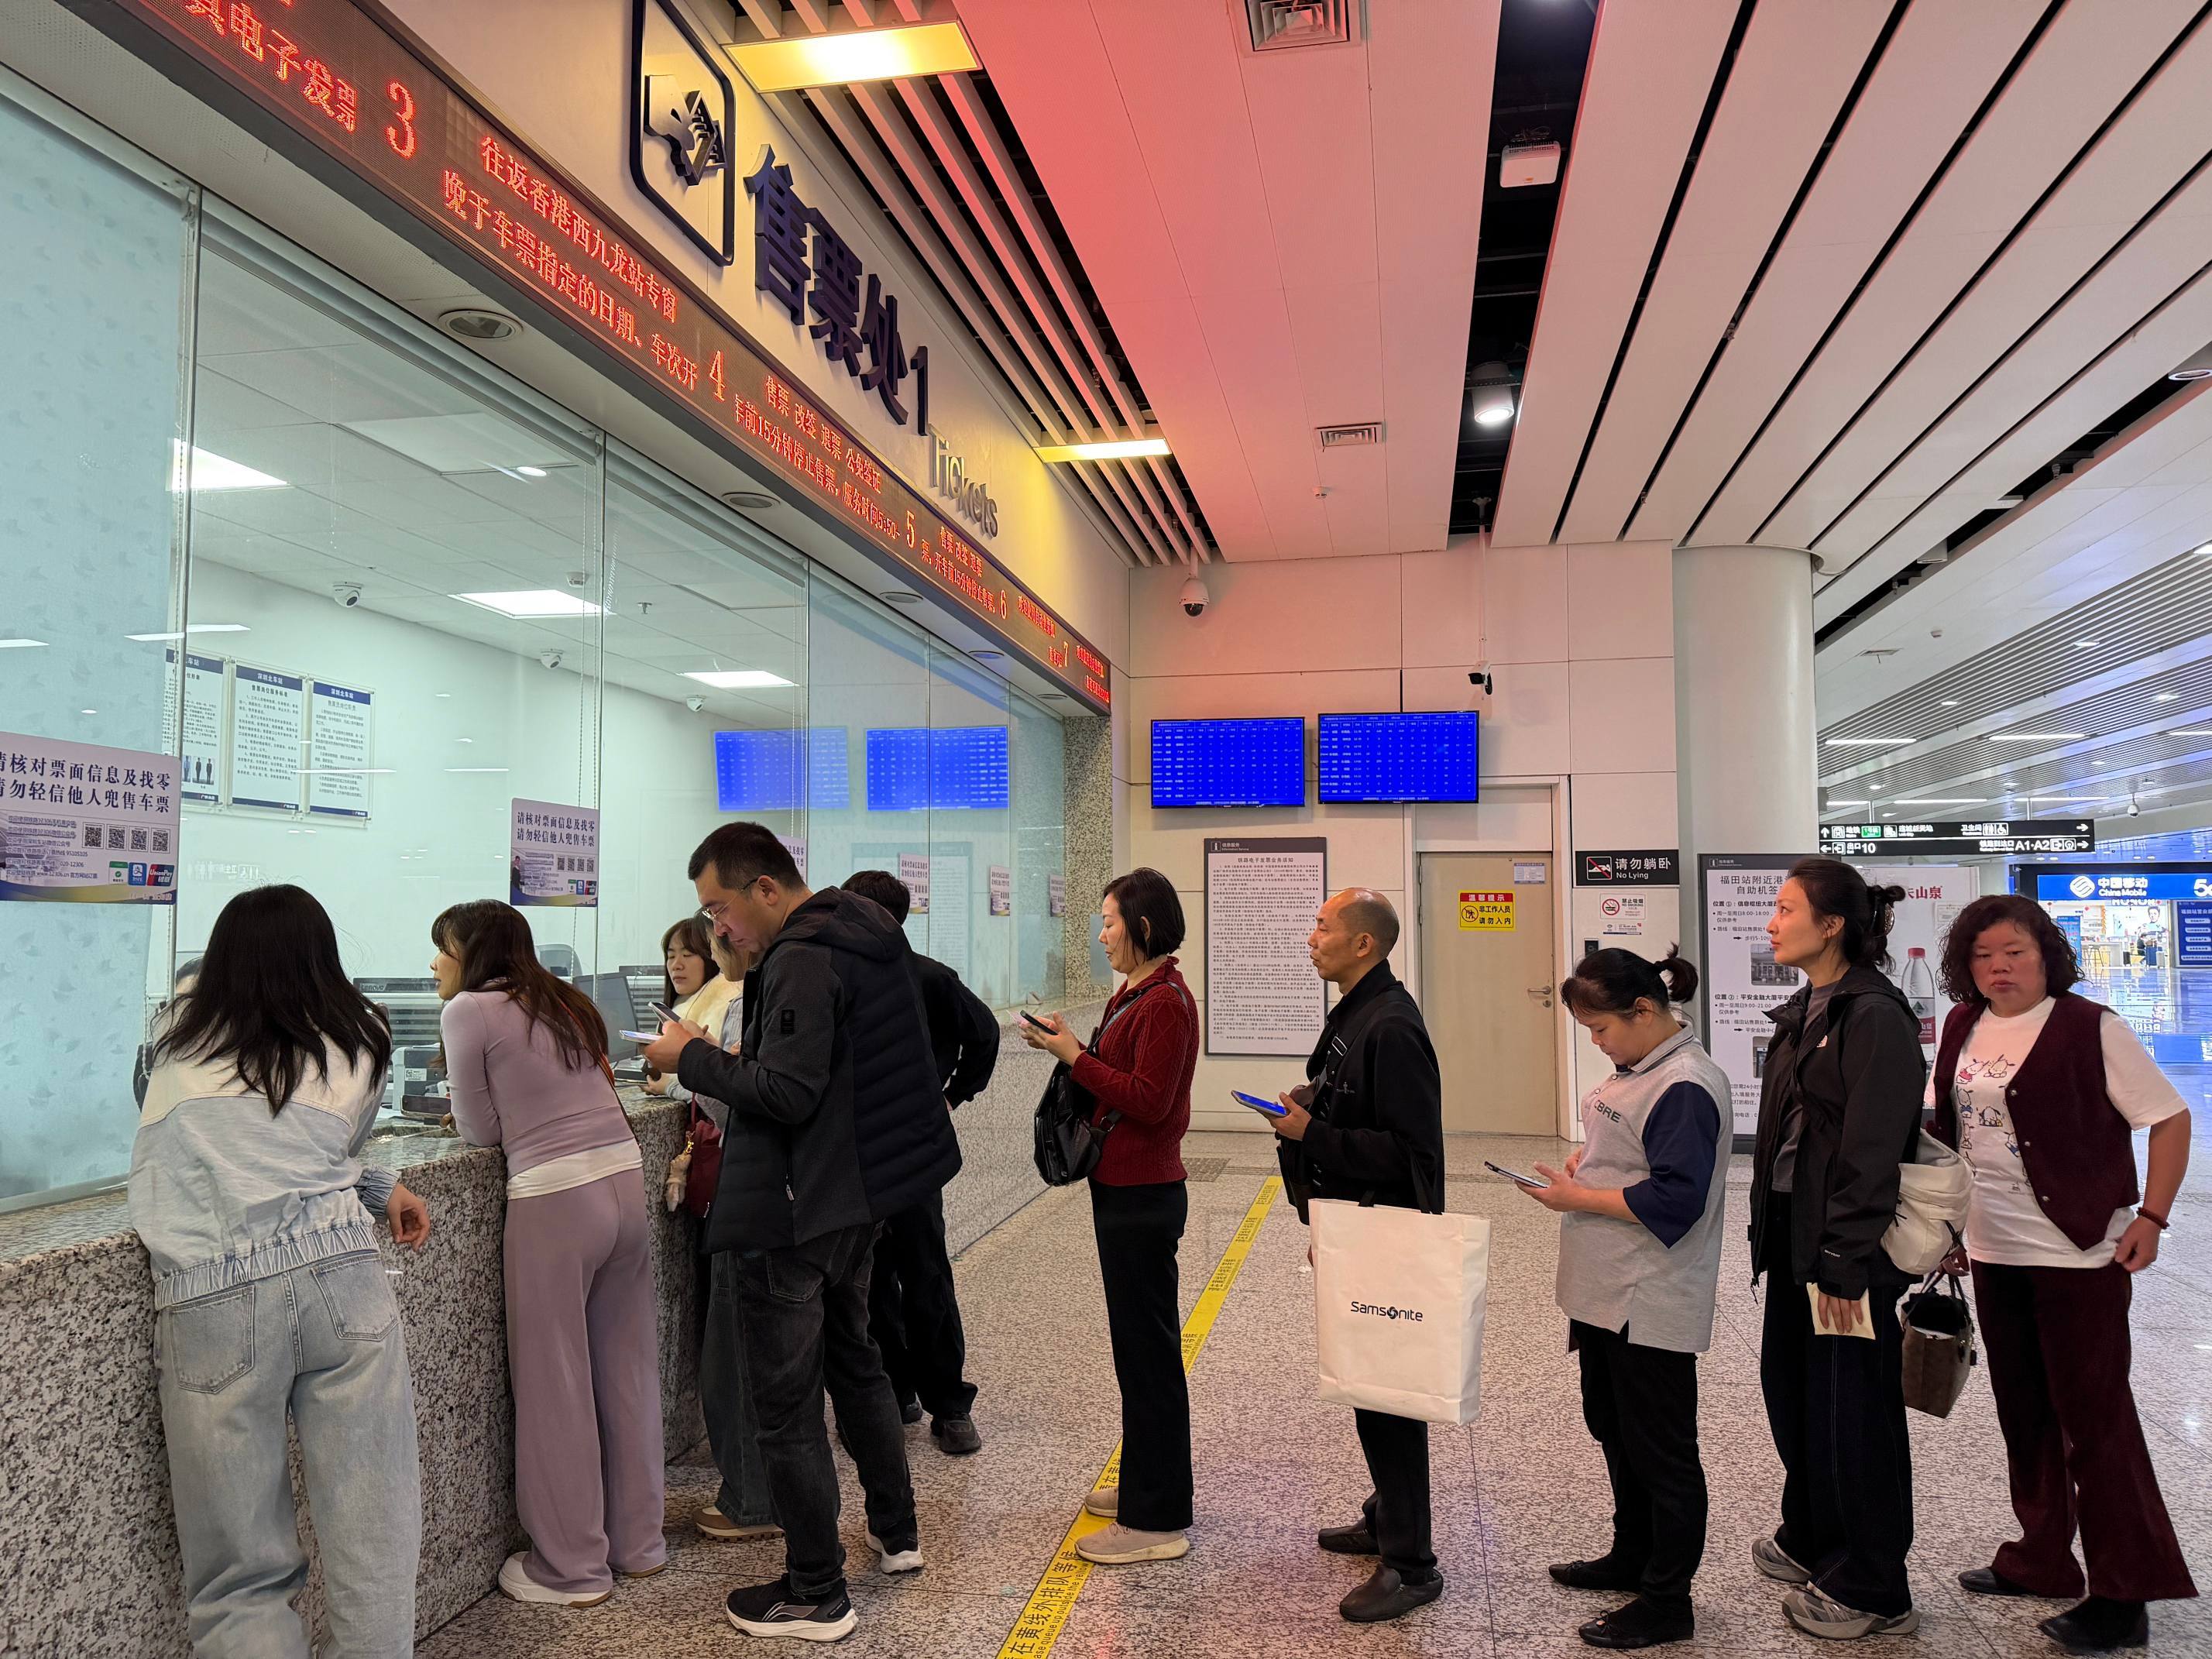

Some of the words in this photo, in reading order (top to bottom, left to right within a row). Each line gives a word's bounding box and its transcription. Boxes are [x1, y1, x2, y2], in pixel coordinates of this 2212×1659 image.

[386, 81, 416, 158] 3
[482, 136, 678, 324] 往返香港西九龙站专窗
[709, 349, 726, 402] 4
[765, 375, 789, 417] 售票
[795, 403, 817, 440] 改签
[820, 423, 842, 461] 退票
[929, 424, 998, 538] Tickets
[905, 510, 915, 548] 5
[939, 525, 954, 555] 售票
[1000, 589, 1008, 620] 6
[1063, 641, 1070, 668] 7
[517, 812, 596, 833] 请核对票面信息及找零
[517, 827, 596, 847] 请勿轻信他人兜售车票
[1861, 842, 1877, 854] 10
[1615, 857, 1671, 871] 请勿躺卧
[1628, 871, 1649, 880] Lying
[1720, 875, 1788, 884] 福田站附近港
[1736, 885, 1782, 895] 自助机签
[2097, 877, 2148, 888] 中国移动
[2098, 888, 2121, 897] China
[2121, 888, 2148, 897] Mobile
[1350, 1300, 1424, 1322] Samsonite
[1004, 1550, 1081, 1659] 在黄线外排队等候
[1041, 1624, 1058, 1645] queue
[1053, 1615, 1064, 1623] up
[1066, 1582, 1080, 1591] the
